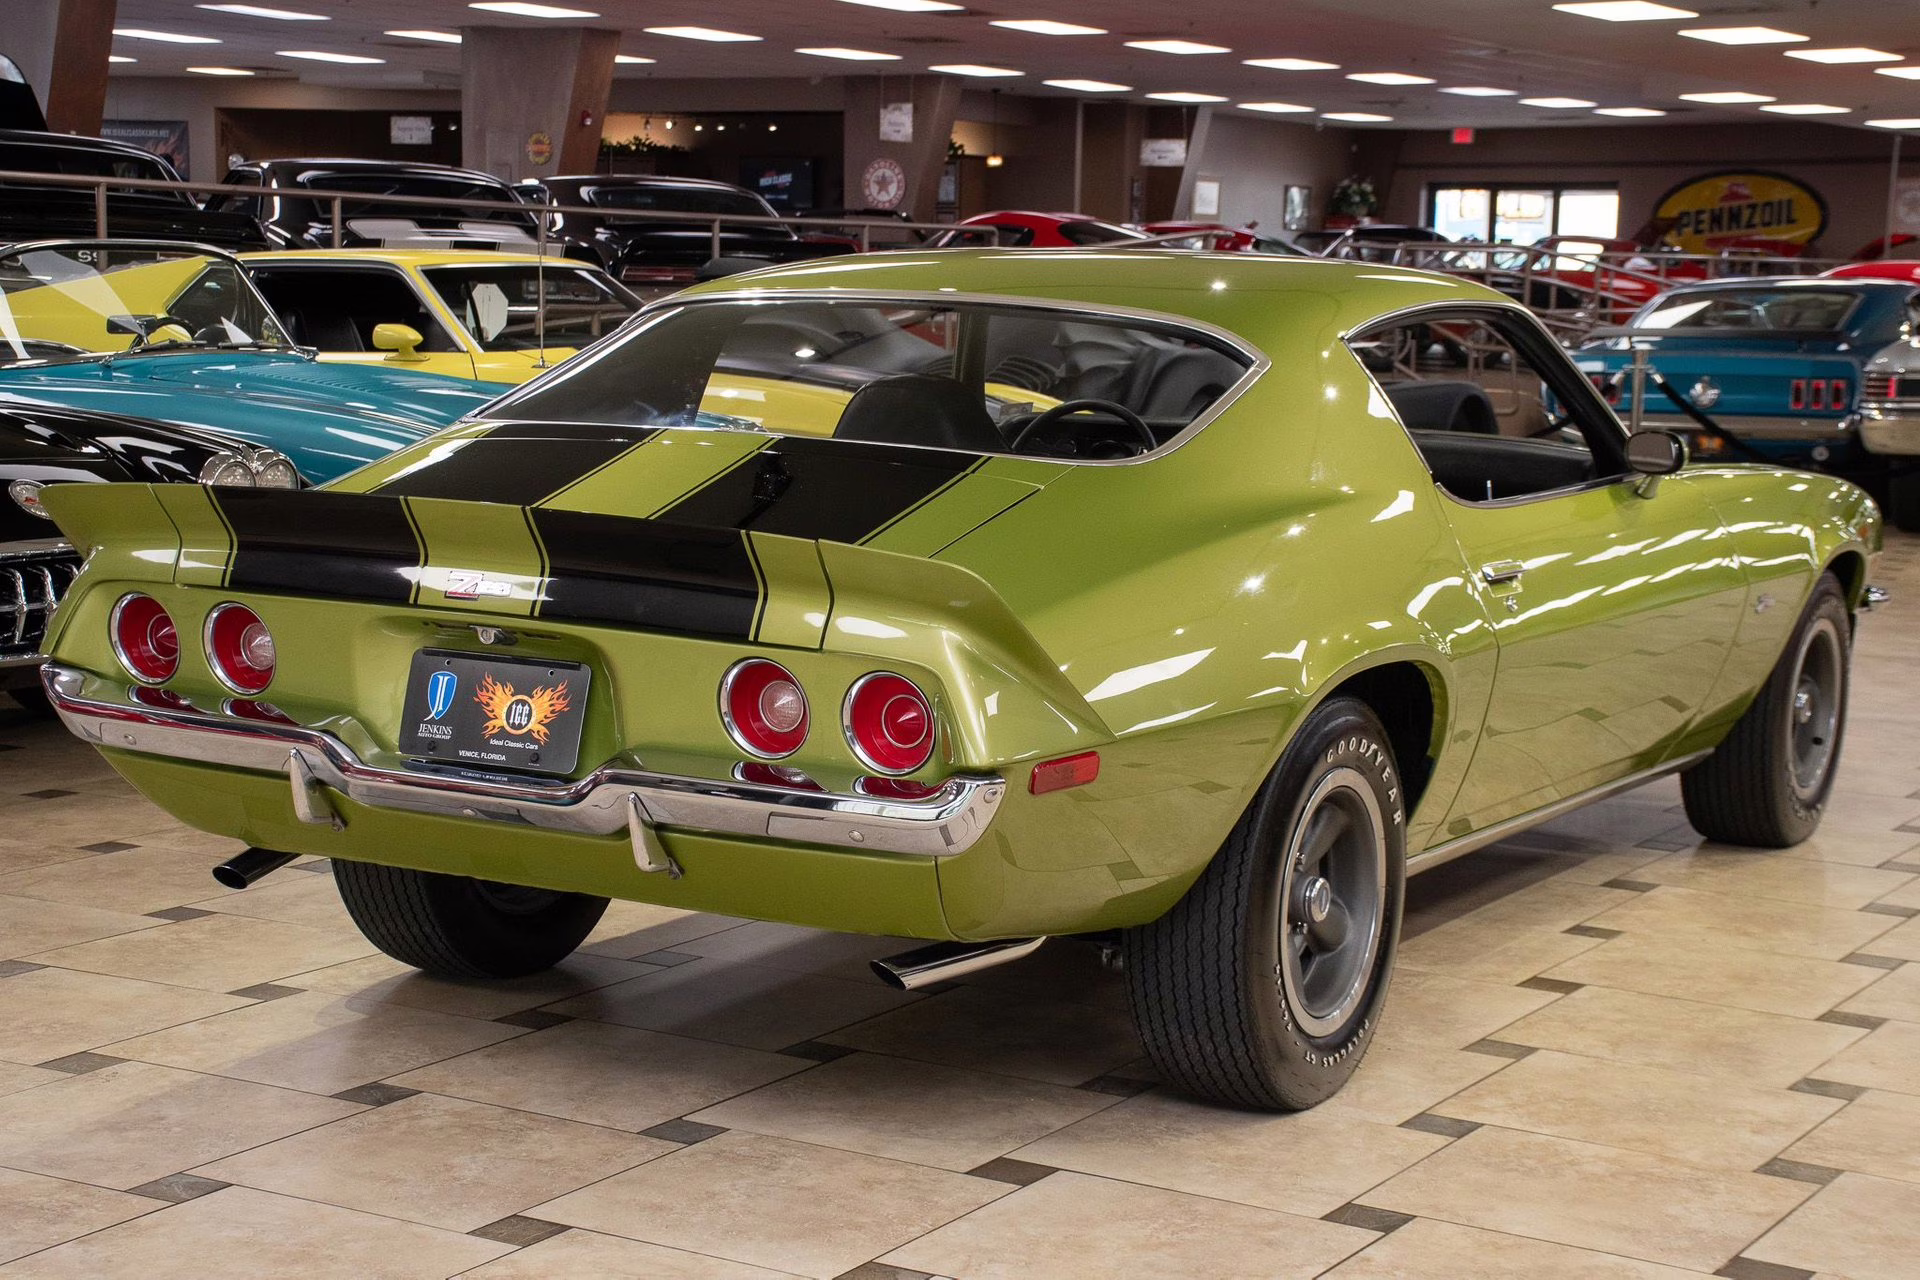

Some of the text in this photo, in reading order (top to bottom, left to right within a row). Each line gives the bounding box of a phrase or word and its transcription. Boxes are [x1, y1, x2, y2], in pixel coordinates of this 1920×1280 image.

[1678, 199, 1797, 236] PENNZOIL
[417, 723, 453, 736] JENKINS
[459, 750, 507, 761] VENICE, FLORIDA
[489, 737, 539, 750] Ideal Classic Cars
[1326, 736, 1402, 825] GOODYEAR
[1321, 1018, 1370, 1068] POLYGLAS
